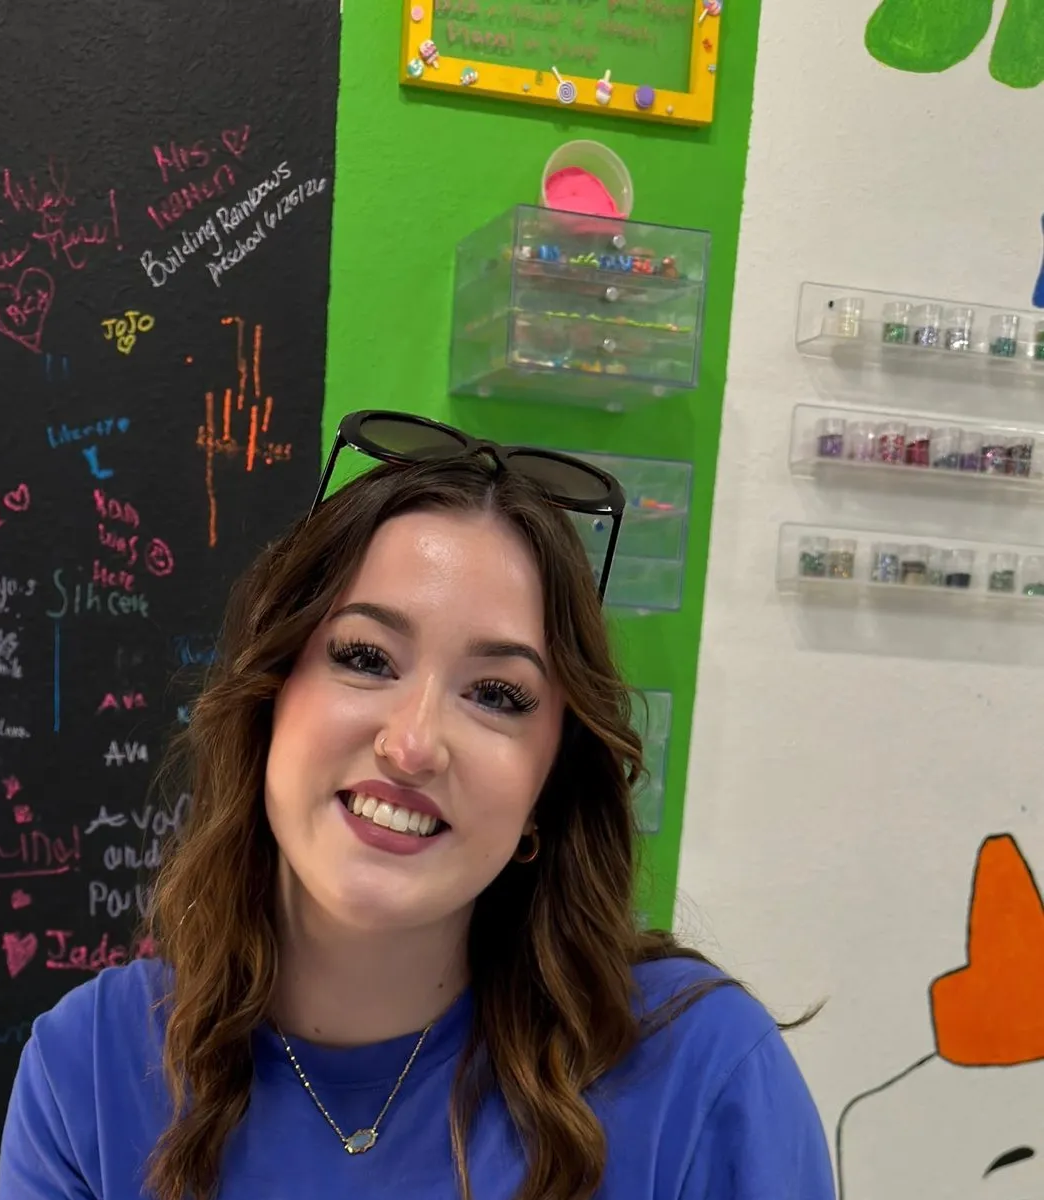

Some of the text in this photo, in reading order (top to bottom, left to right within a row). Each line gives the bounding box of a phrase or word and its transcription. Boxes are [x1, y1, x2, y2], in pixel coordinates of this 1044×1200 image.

[140, 160, 293, 288] Building Rainbows
[205, 221, 267, 288] preschool
